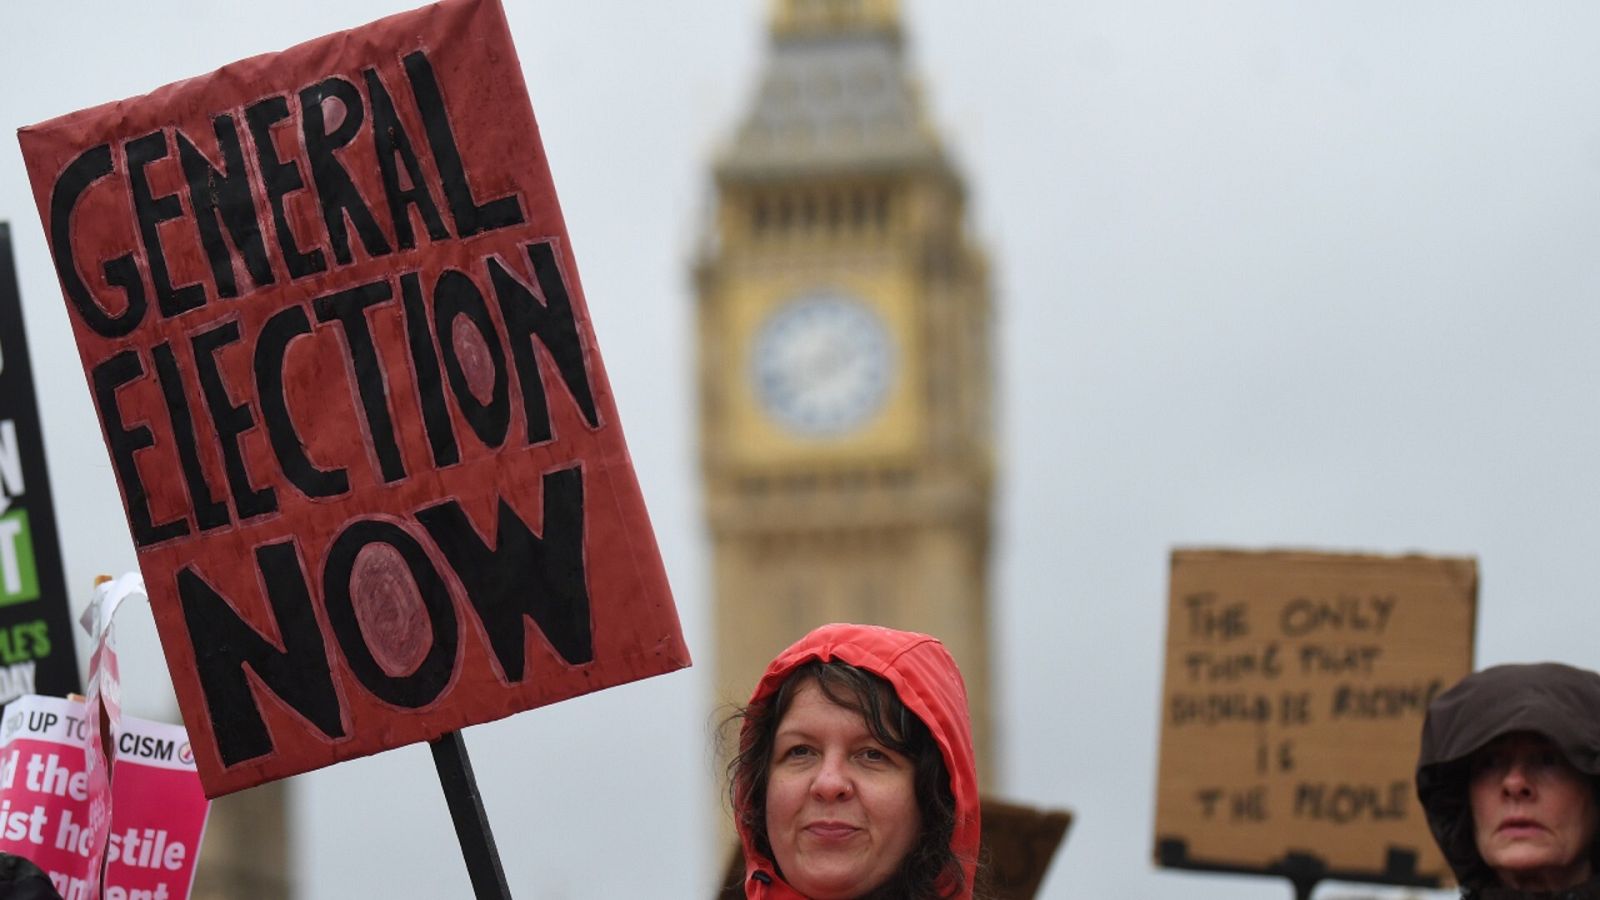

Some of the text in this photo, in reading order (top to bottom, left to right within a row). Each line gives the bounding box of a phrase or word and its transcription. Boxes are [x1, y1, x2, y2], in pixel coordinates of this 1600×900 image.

[50, 50, 526, 337] GENERAL
[93, 242, 601, 547] ELECTION
[176, 465, 594, 768] NOW
[1184, 592, 1398, 641] THE ONLY
[1299, 643, 1382, 676] THAT
[28, 711, 57, 733] UP
[26, 753, 88, 801] the
[1197, 780, 1410, 824] THE PEOPLE
